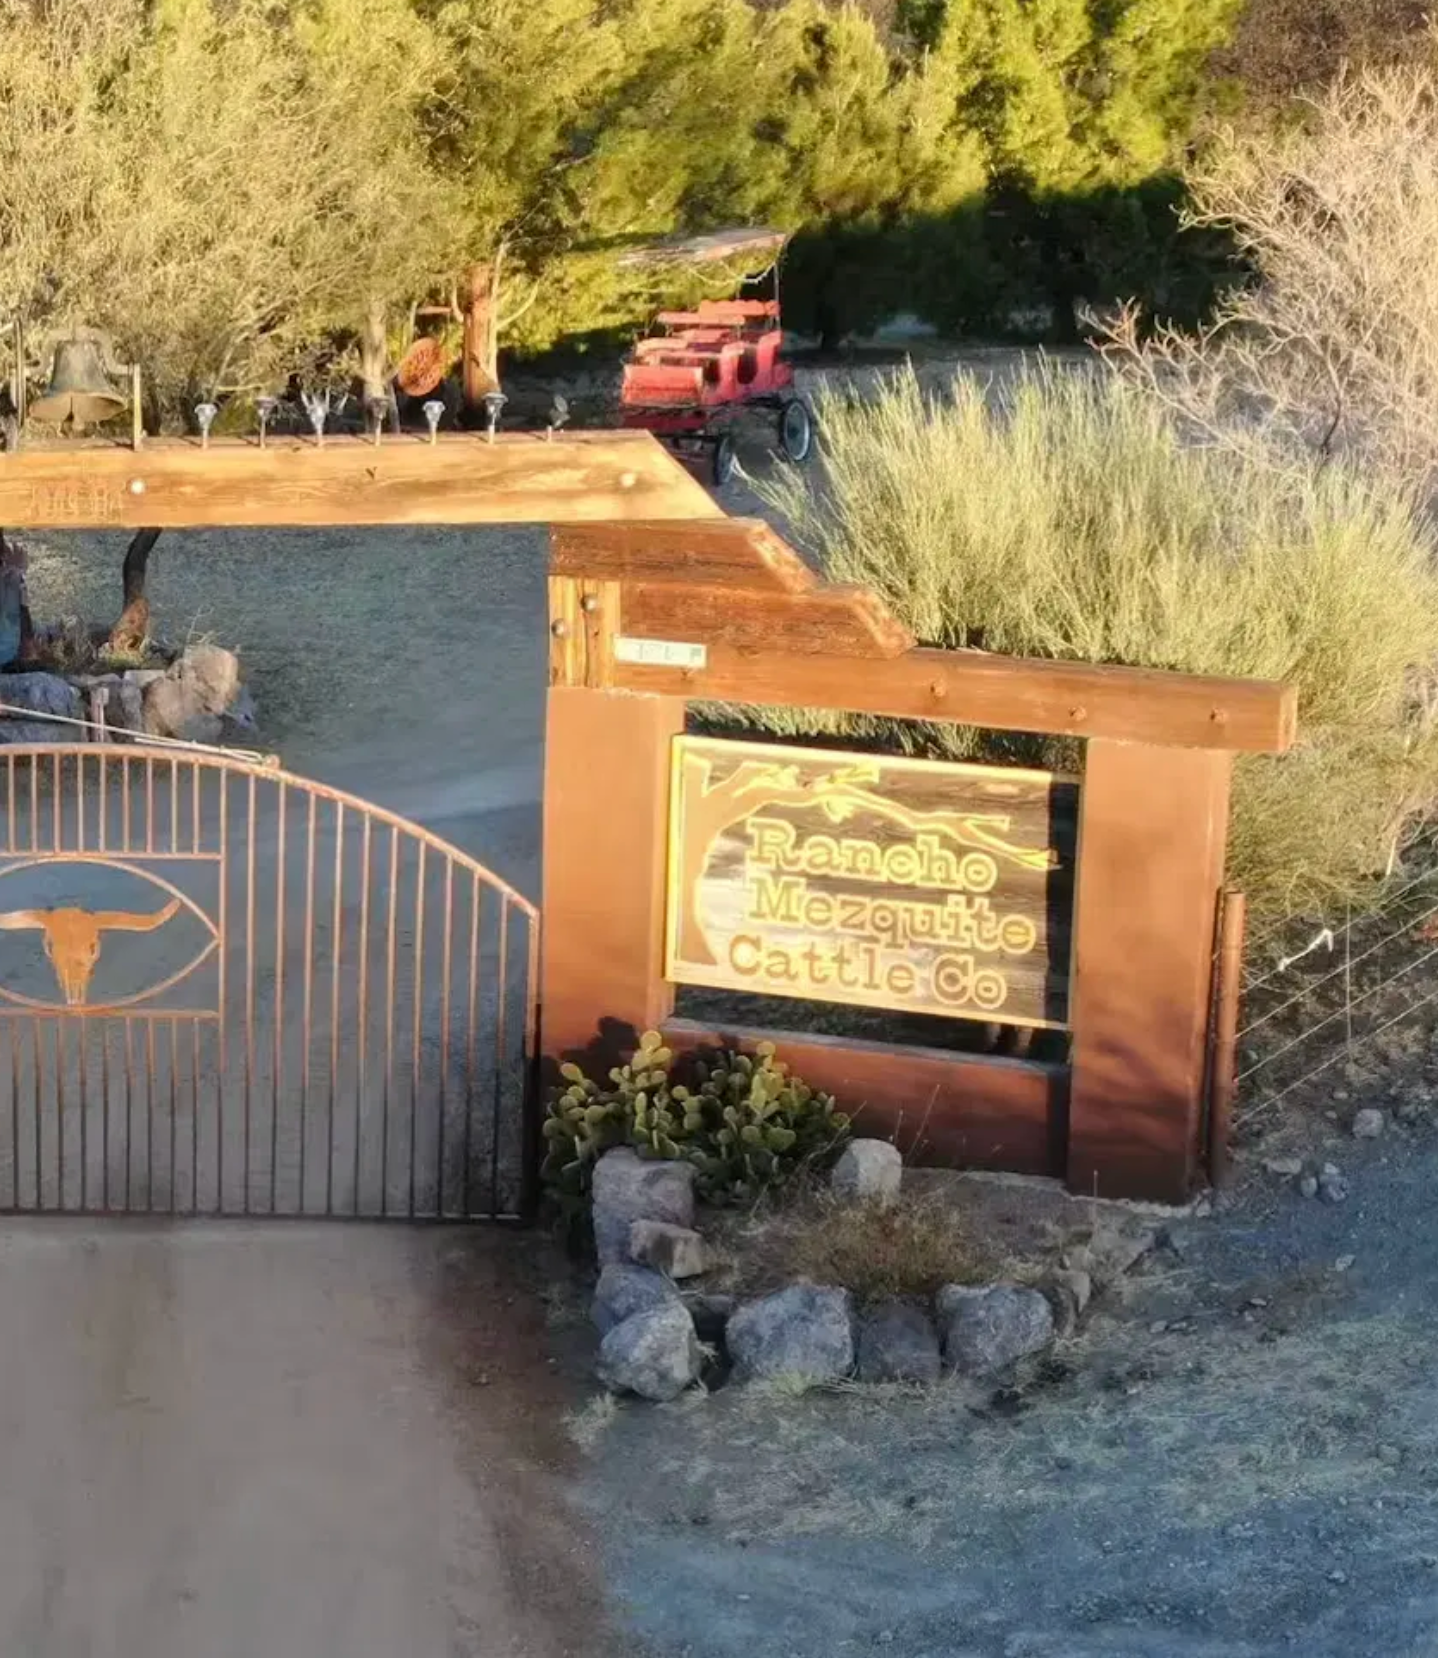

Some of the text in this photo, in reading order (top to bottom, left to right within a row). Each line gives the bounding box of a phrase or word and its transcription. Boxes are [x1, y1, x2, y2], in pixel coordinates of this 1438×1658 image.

[748, 819, 996, 891] Rancho
[748, 876, 1035, 953] Mezquite
[728, 932, 1006, 1007] Cattle Co
